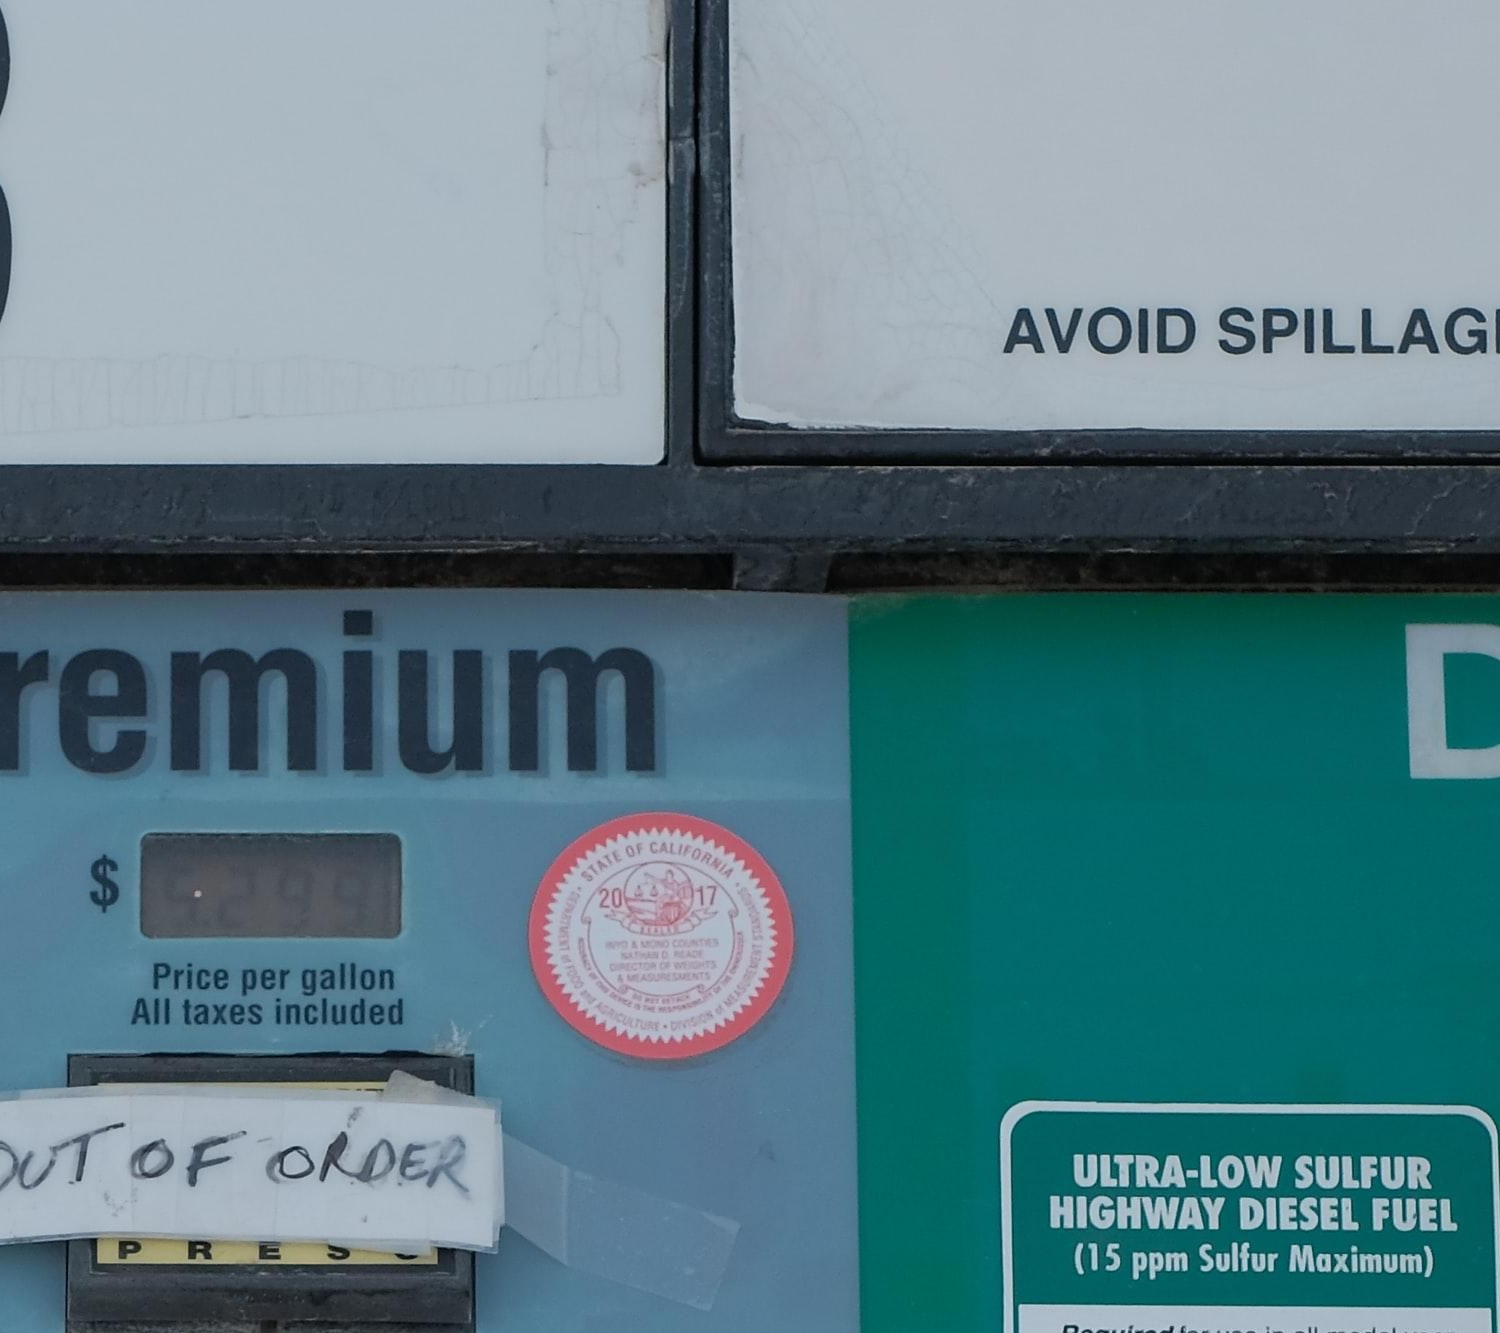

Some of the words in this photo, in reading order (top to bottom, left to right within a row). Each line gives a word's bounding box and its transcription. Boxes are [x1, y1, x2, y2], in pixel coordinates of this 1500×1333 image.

[1002, 307, 1198, 355] AVOID
[580, 853, 621, 882] STATE
[627, 843, 643, 858] OF
[650, 841, 733, 877] CALIFORNIA
[90, 854, 119, 913] $
[152, 963, 229, 990] Price
[242, 968, 290, 996] per
[301, 963, 395, 996] gallon
[131, 998, 170, 1025] All
[182, 999, 263, 1025] taxes
[275, 998, 404, 1025] included
[131, 1130, 246, 1187] OF
[268, 1129, 470, 1192] ORDER
[1073, 1154, 1282, 1188] ULTRA-LOW
[1294, 1156, 1432, 1190] SULFUR
[1049, 1196, 1225, 1229] HIGHWAY
[1240, 1197, 1358, 1231] DIESEL
[1371, 1198, 1458, 1232] FUEL
[1074, 1242, 1121, 1275] (15
[1132, 1249, 1189, 1279] ppm
[1199, 1242, 1279, 1273] Sulfur
[1289, 1244, 1434, 1278] Maximum)
